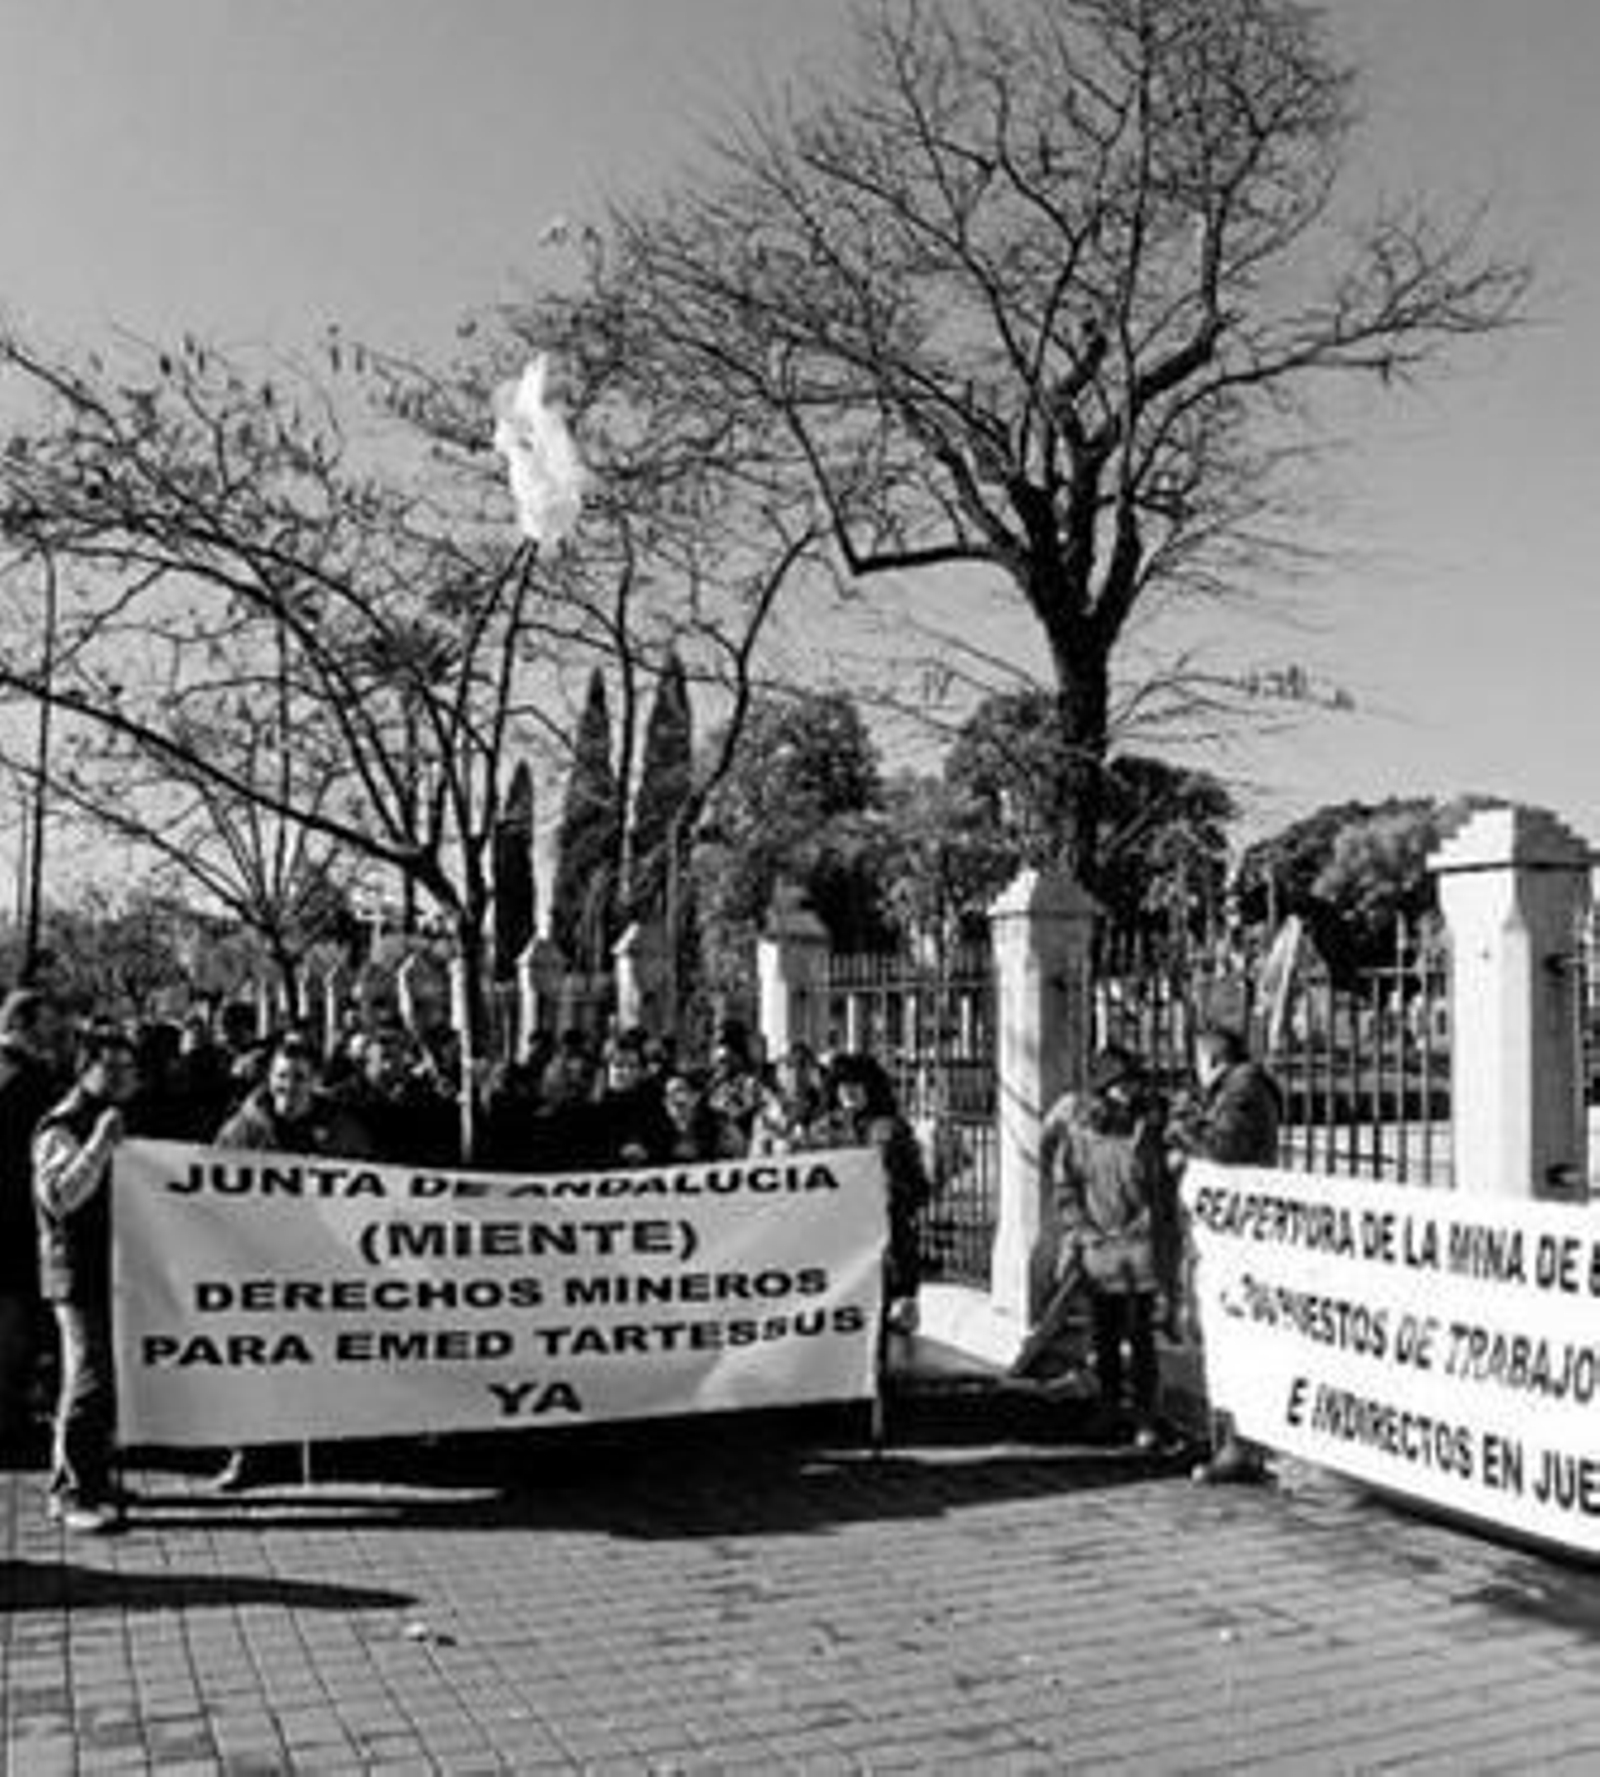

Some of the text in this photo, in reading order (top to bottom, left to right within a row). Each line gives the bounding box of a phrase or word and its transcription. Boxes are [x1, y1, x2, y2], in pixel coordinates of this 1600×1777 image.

[167, 1164, 386, 1198] JUNTA
[506, 1164, 839, 1199] ANDALUCIA
[361, 1220, 697, 1265] (MIENTE)
[1196, 1187, 1354, 1260] REAPERTURA
[1360, 1209, 1396, 1264] DE
[1404, 1217, 1438, 1271] LA
[1448, 1221, 1526, 1284] MINA
[1536, 1233, 1580, 1293] DE
[196, 1269, 829, 1312] DERECHOS MINEROS
[142, 1306, 864, 1366] PARA EMED TARTESSUS
[1396, 1313, 1438, 1370] DE
[487, 1382, 582, 1416] YA
[1287, 1376, 1309, 1427] E
[1311, 1382, 1473, 1480] INDIRECTOS
[1483, 1433, 1524, 1494] EN
